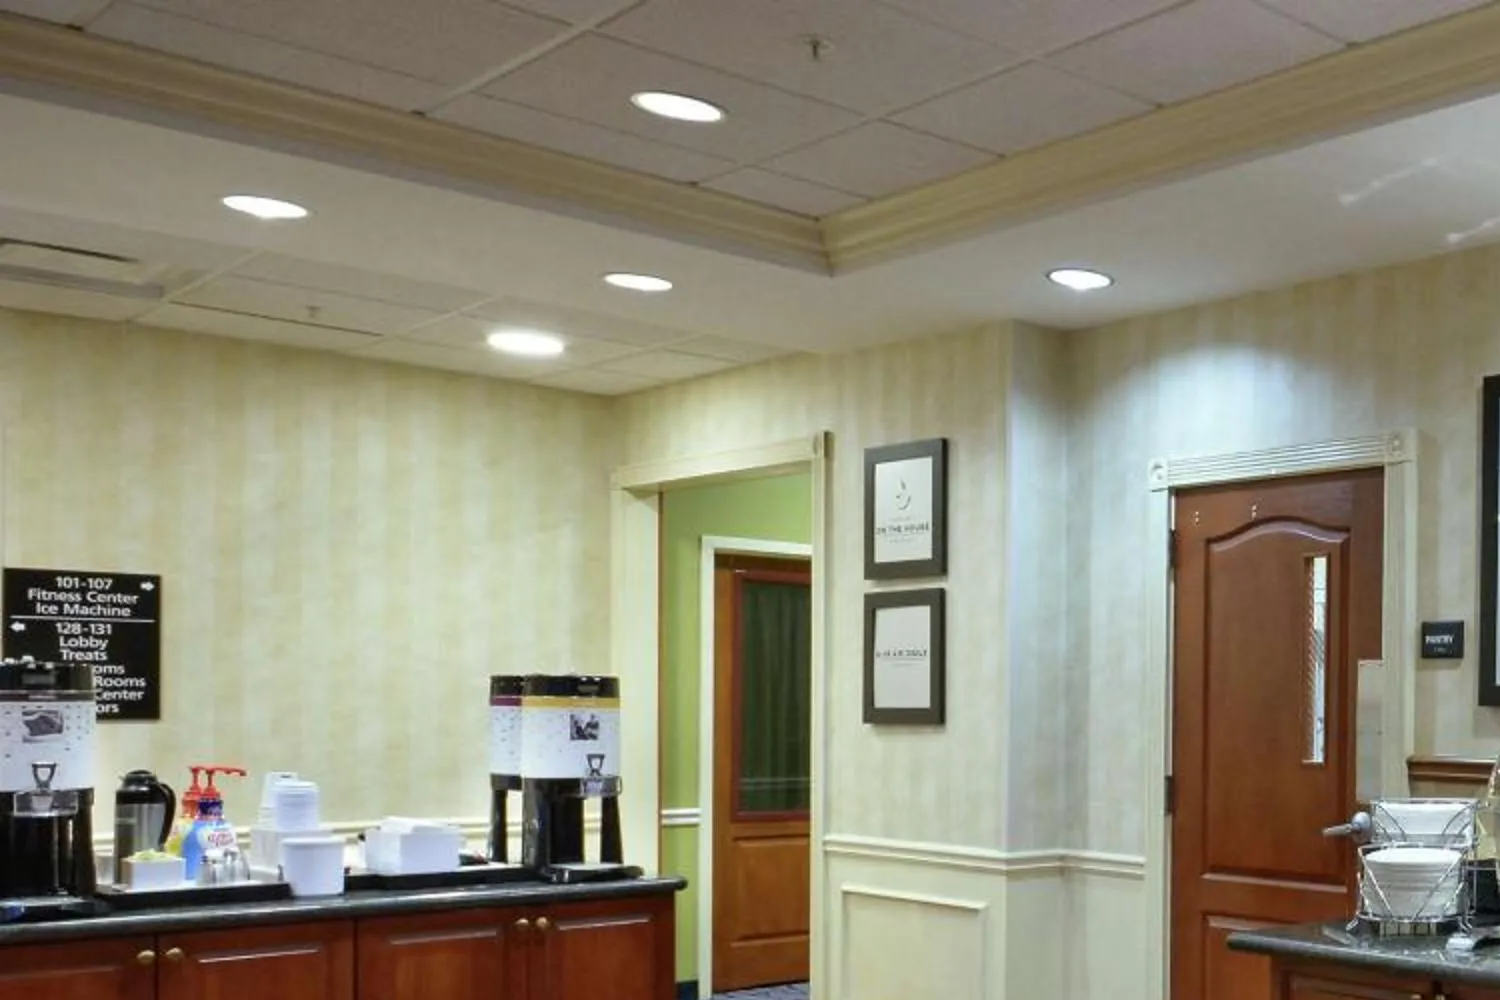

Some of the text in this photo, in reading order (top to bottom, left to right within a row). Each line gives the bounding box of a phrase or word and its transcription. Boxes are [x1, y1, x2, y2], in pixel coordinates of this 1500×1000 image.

[56, 576, 113, 590] 101-107
[28, 587, 139, 605] Fitness Center
[35, 602, 132, 617] Ice Machine
[56, 622, 113, 636] 128-131
[59, 635, 109, 651] Lobby
[60, 649, 108, 661] Treats
[92, 675, 147, 688] Rooms
[94, 688, 145, 701] Center
